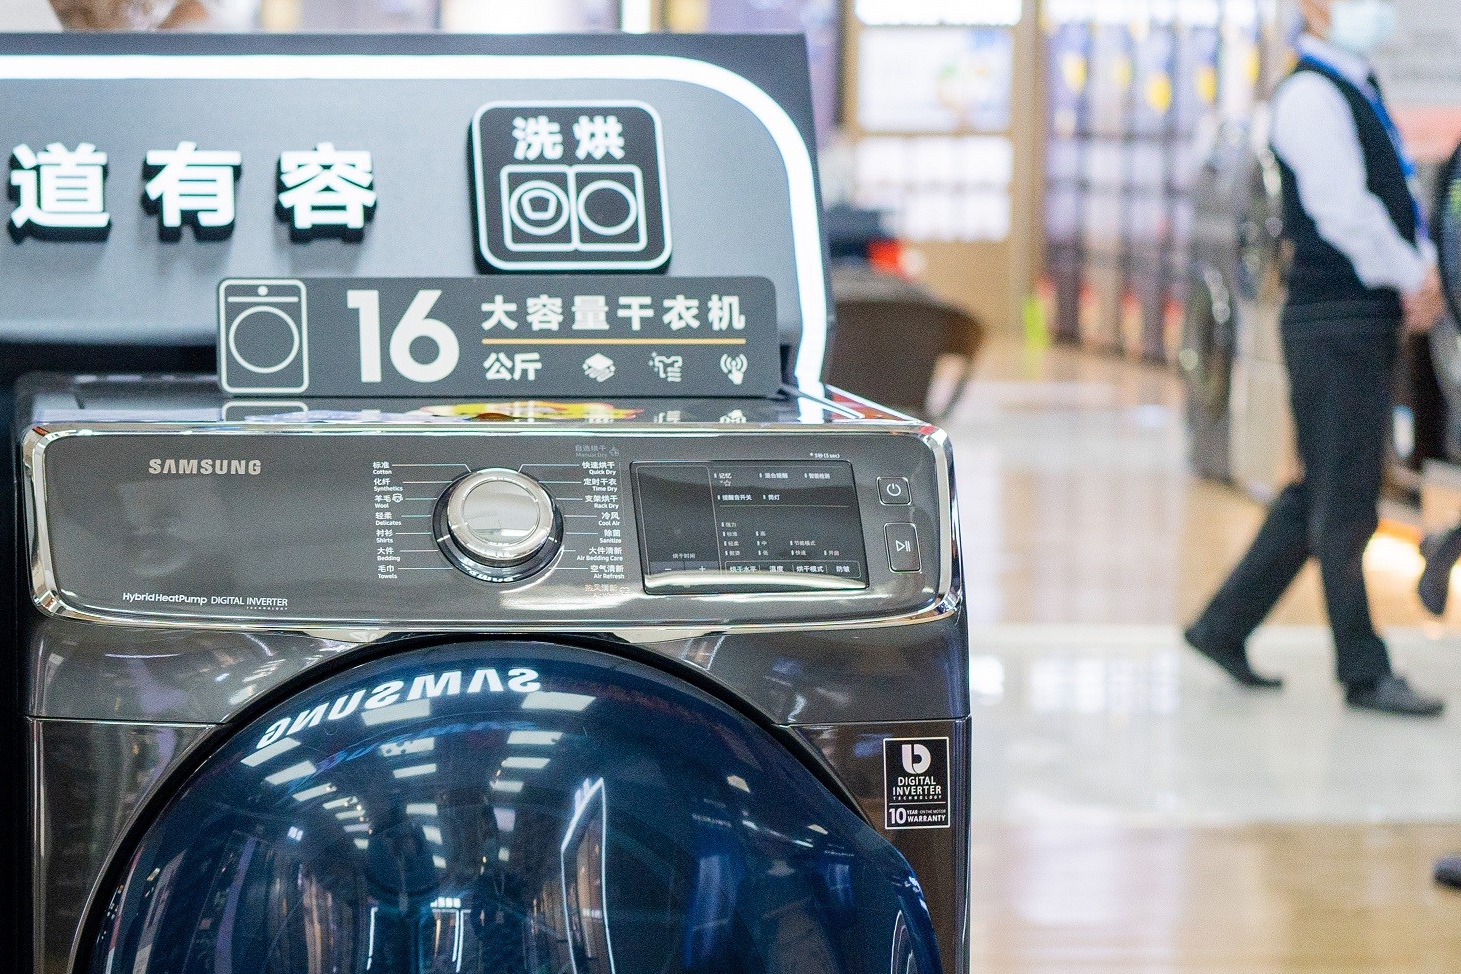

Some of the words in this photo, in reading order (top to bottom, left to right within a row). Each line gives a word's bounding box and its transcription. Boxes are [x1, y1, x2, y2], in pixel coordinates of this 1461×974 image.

[512, 116, 626, 160] 洗烘
[481, 294, 746, 331] 大容量干衣机
[347, 289, 460, 383] 16
[482, 352, 543, 382] 公斤
[148, 459, 262, 475] SAMSUNG
[372, 461, 390, 469] 标准
[582, 461, 615, 469] 快速烘干
[374, 478, 390, 486] 化纤
[374, 494, 392, 502] 羊毛
[376, 512, 392, 520] 轻柔
[602, 512, 620, 520] 冷风
[376, 529, 393, 537] 衬衫
[377, 546, 394, 554] 大件
[378, 564, 394, 572] 毛巾
[590, 564, 624, 572] 空气清新
[210, 596, 245, 605] DIGITAL
[246, 597, 288, 606] INVERTER
[898, 776, 937, 786] DIGITAL
[892, 785, 942, 796] INVERTER
[888, 808, 906, 824] 10
[907, 814, 946, 822] WARRANTY
